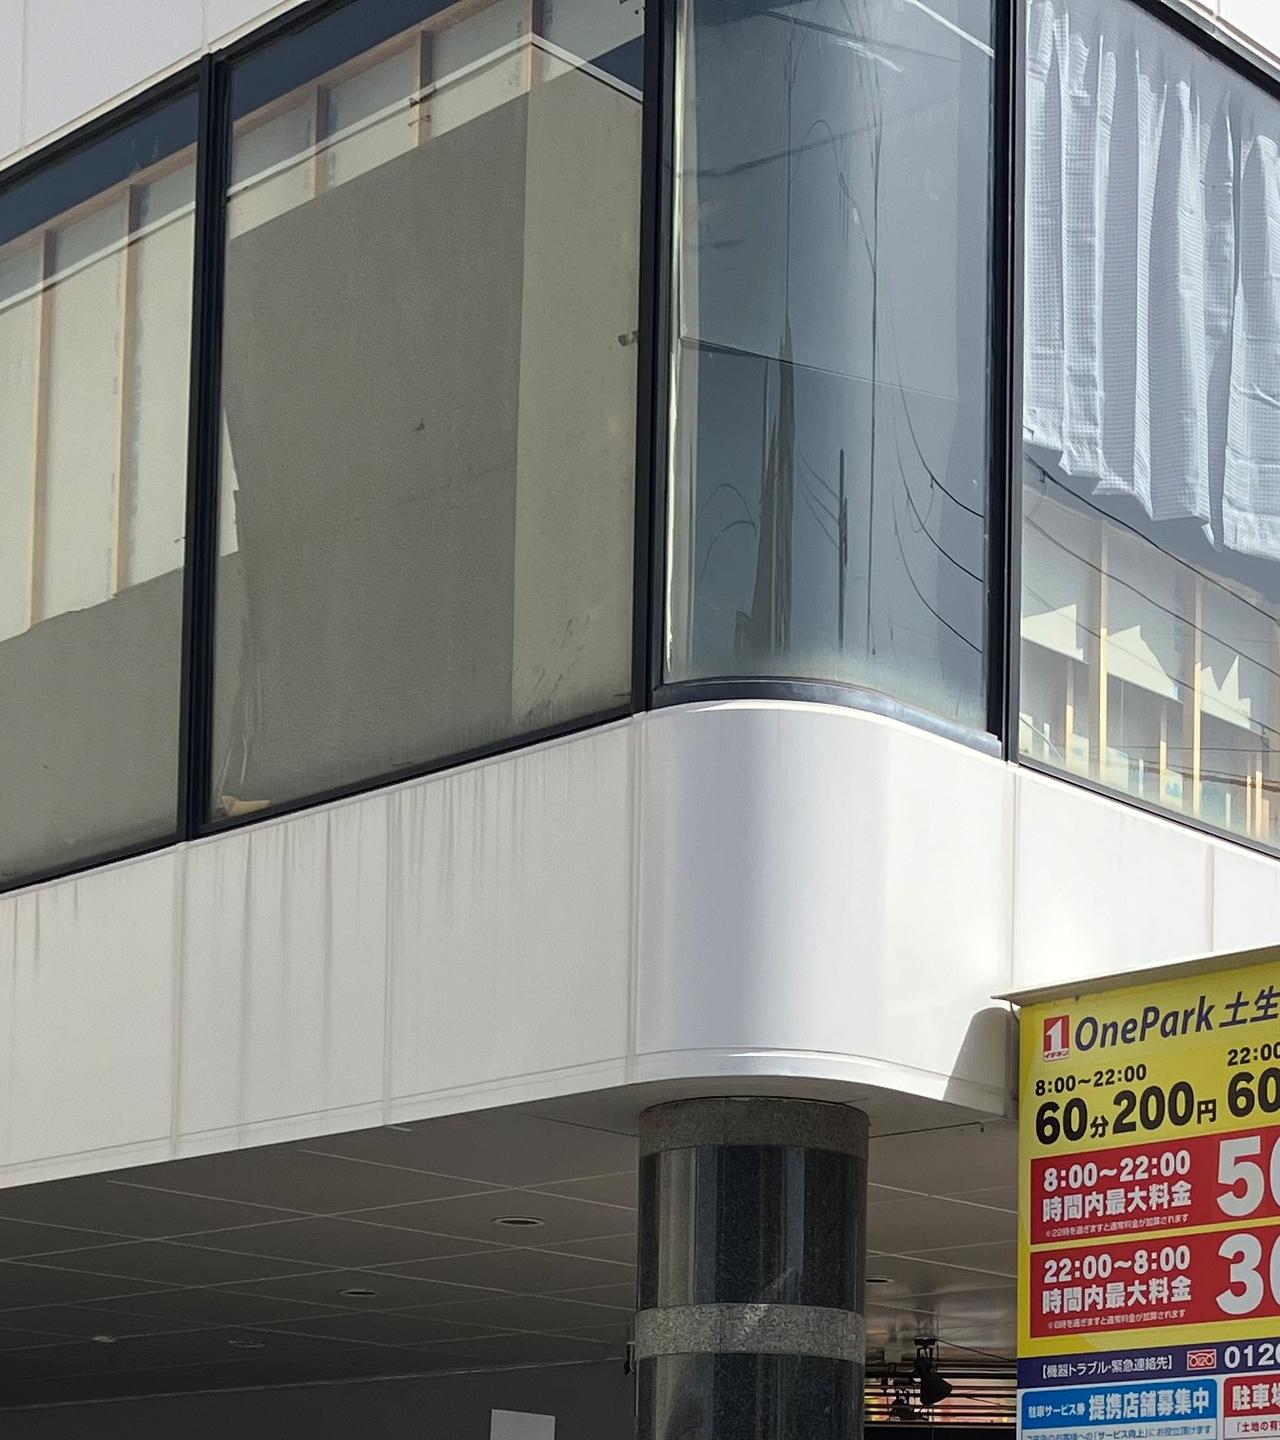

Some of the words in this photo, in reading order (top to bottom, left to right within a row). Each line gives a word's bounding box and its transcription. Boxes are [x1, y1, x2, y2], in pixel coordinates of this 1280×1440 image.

[1074, 995, 1214, 1053] OnePark
[1042, 1180, 1193, 1223] 時間内最大料金
[1042, 1275, 1192, 1314] 時間内最大料金
[1088, 1387, 1210, 1421] 提携店舗募集中
